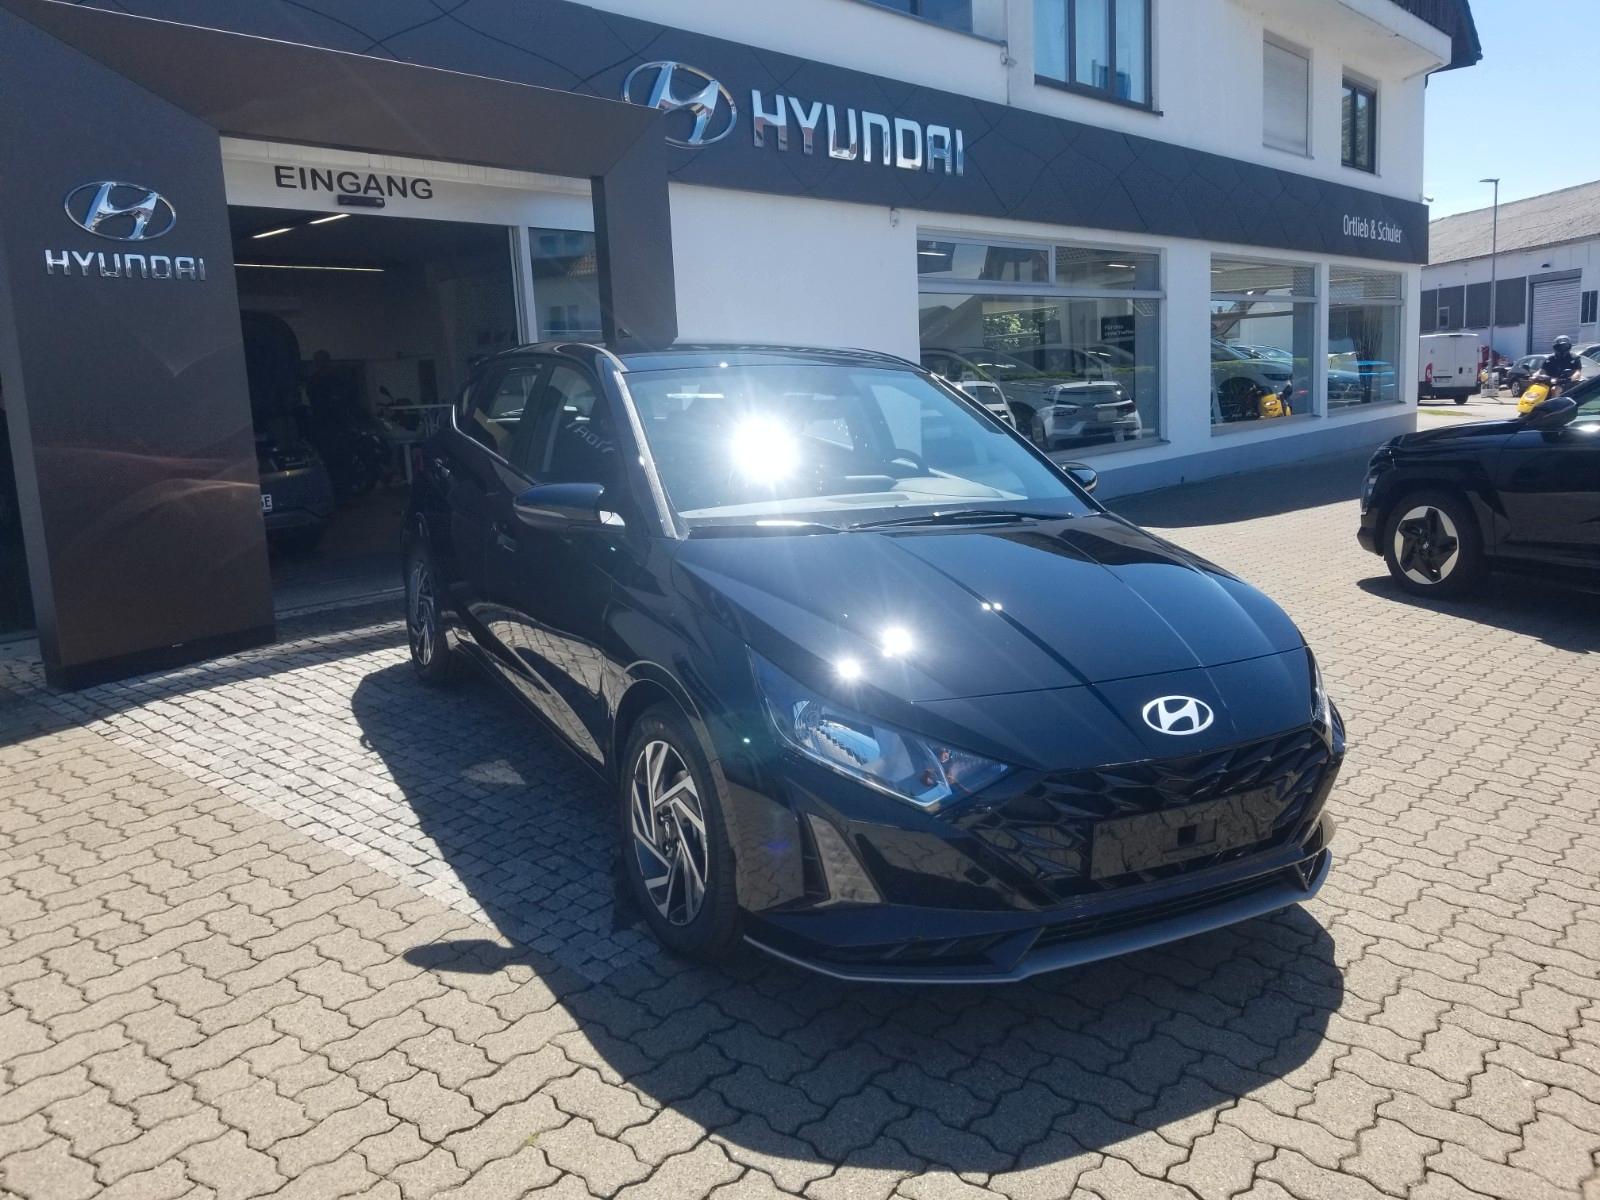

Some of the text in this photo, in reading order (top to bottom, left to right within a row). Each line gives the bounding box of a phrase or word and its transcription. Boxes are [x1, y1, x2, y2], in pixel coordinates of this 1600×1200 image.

[752, 89, 964, 176] HYUNDAI
[275, 165, 434, 199] EINGANG
[1343, 214, 1402, 243] Ortlieb & Schuler
[45, 249, 205, 281] HYUNDAI
